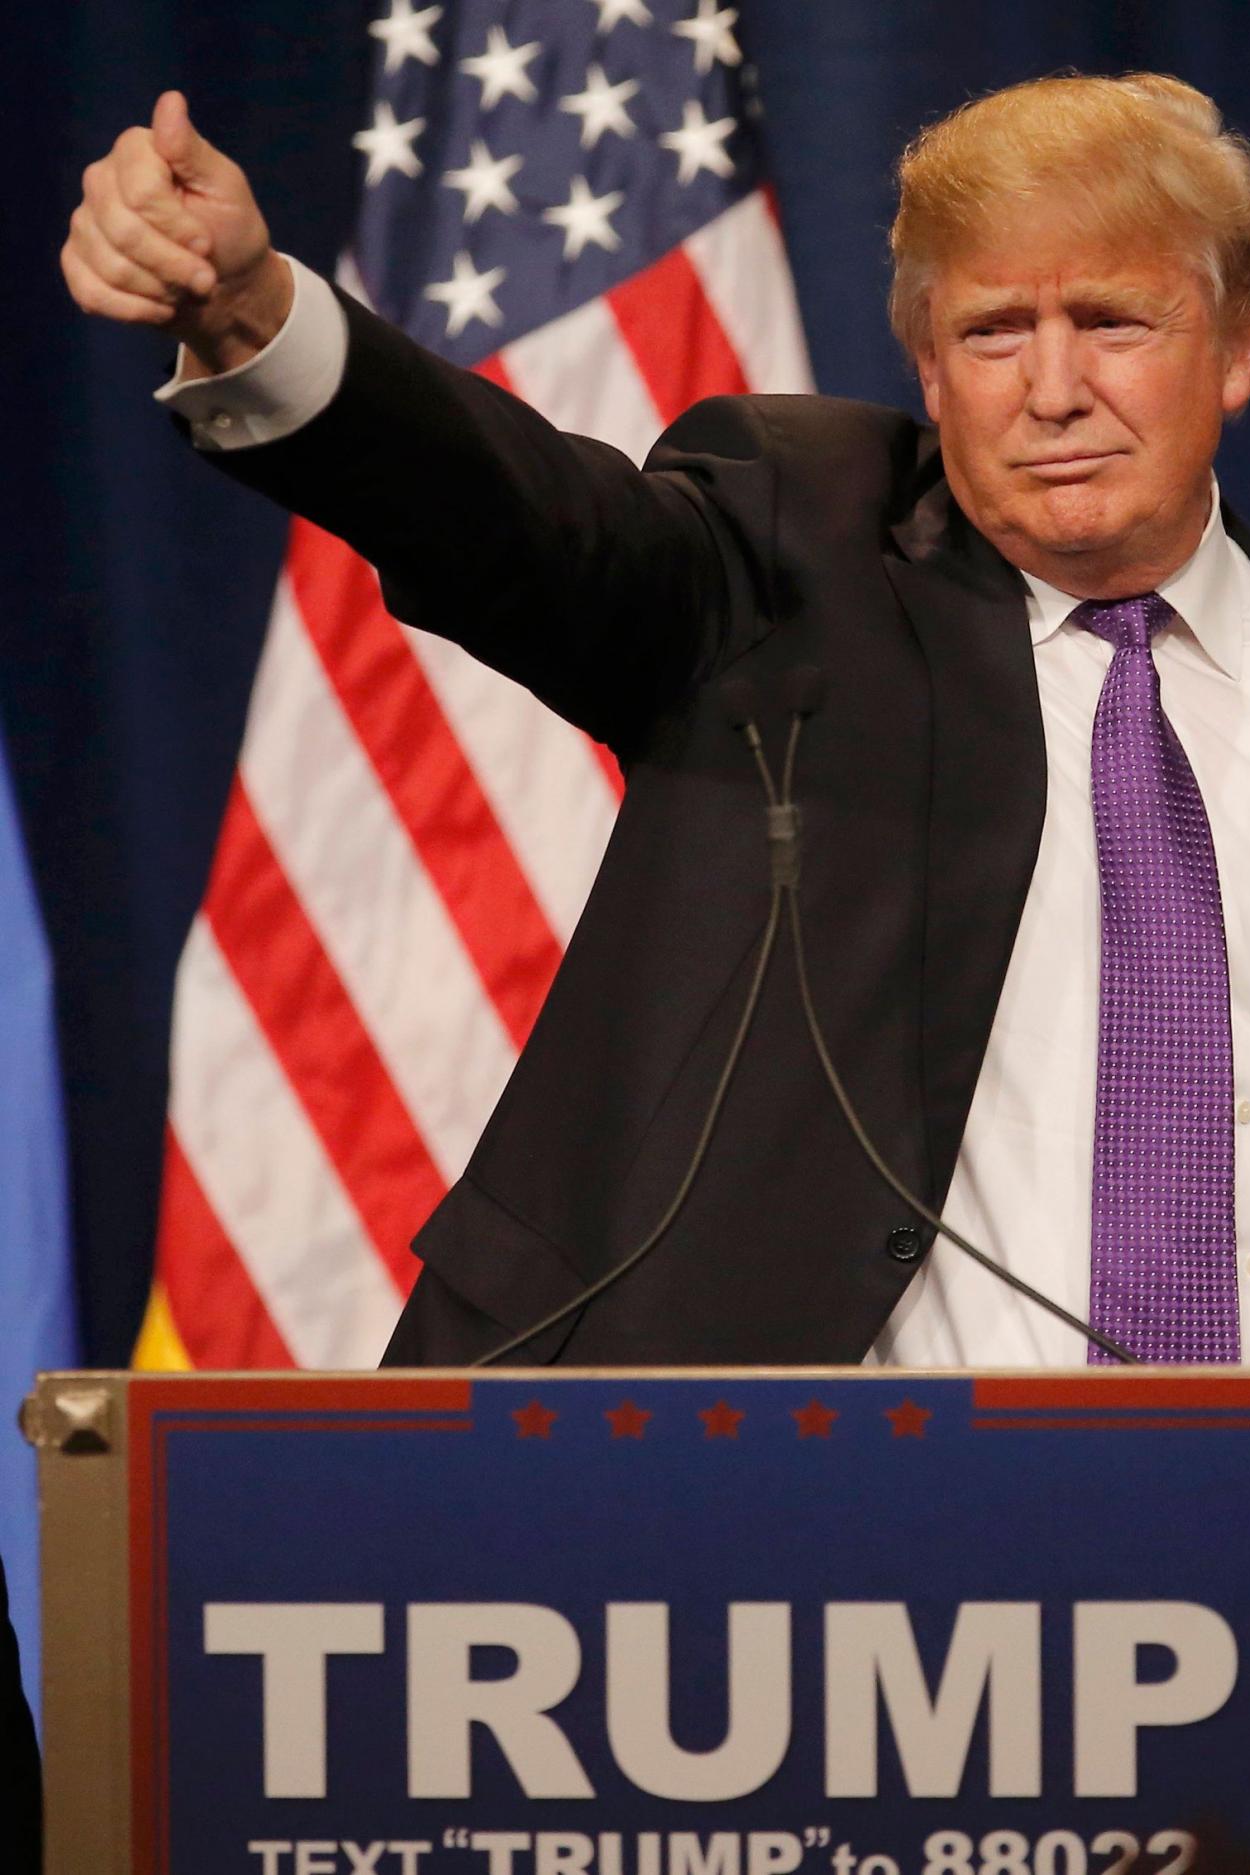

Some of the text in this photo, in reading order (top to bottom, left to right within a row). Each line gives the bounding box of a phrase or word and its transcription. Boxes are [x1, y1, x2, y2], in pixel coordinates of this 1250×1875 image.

[203, 1601, 1239, 1802] TRUMP
[247, 1840, 433, 1875] TEXT
[922, 1829, 1196, 1875] 88022
